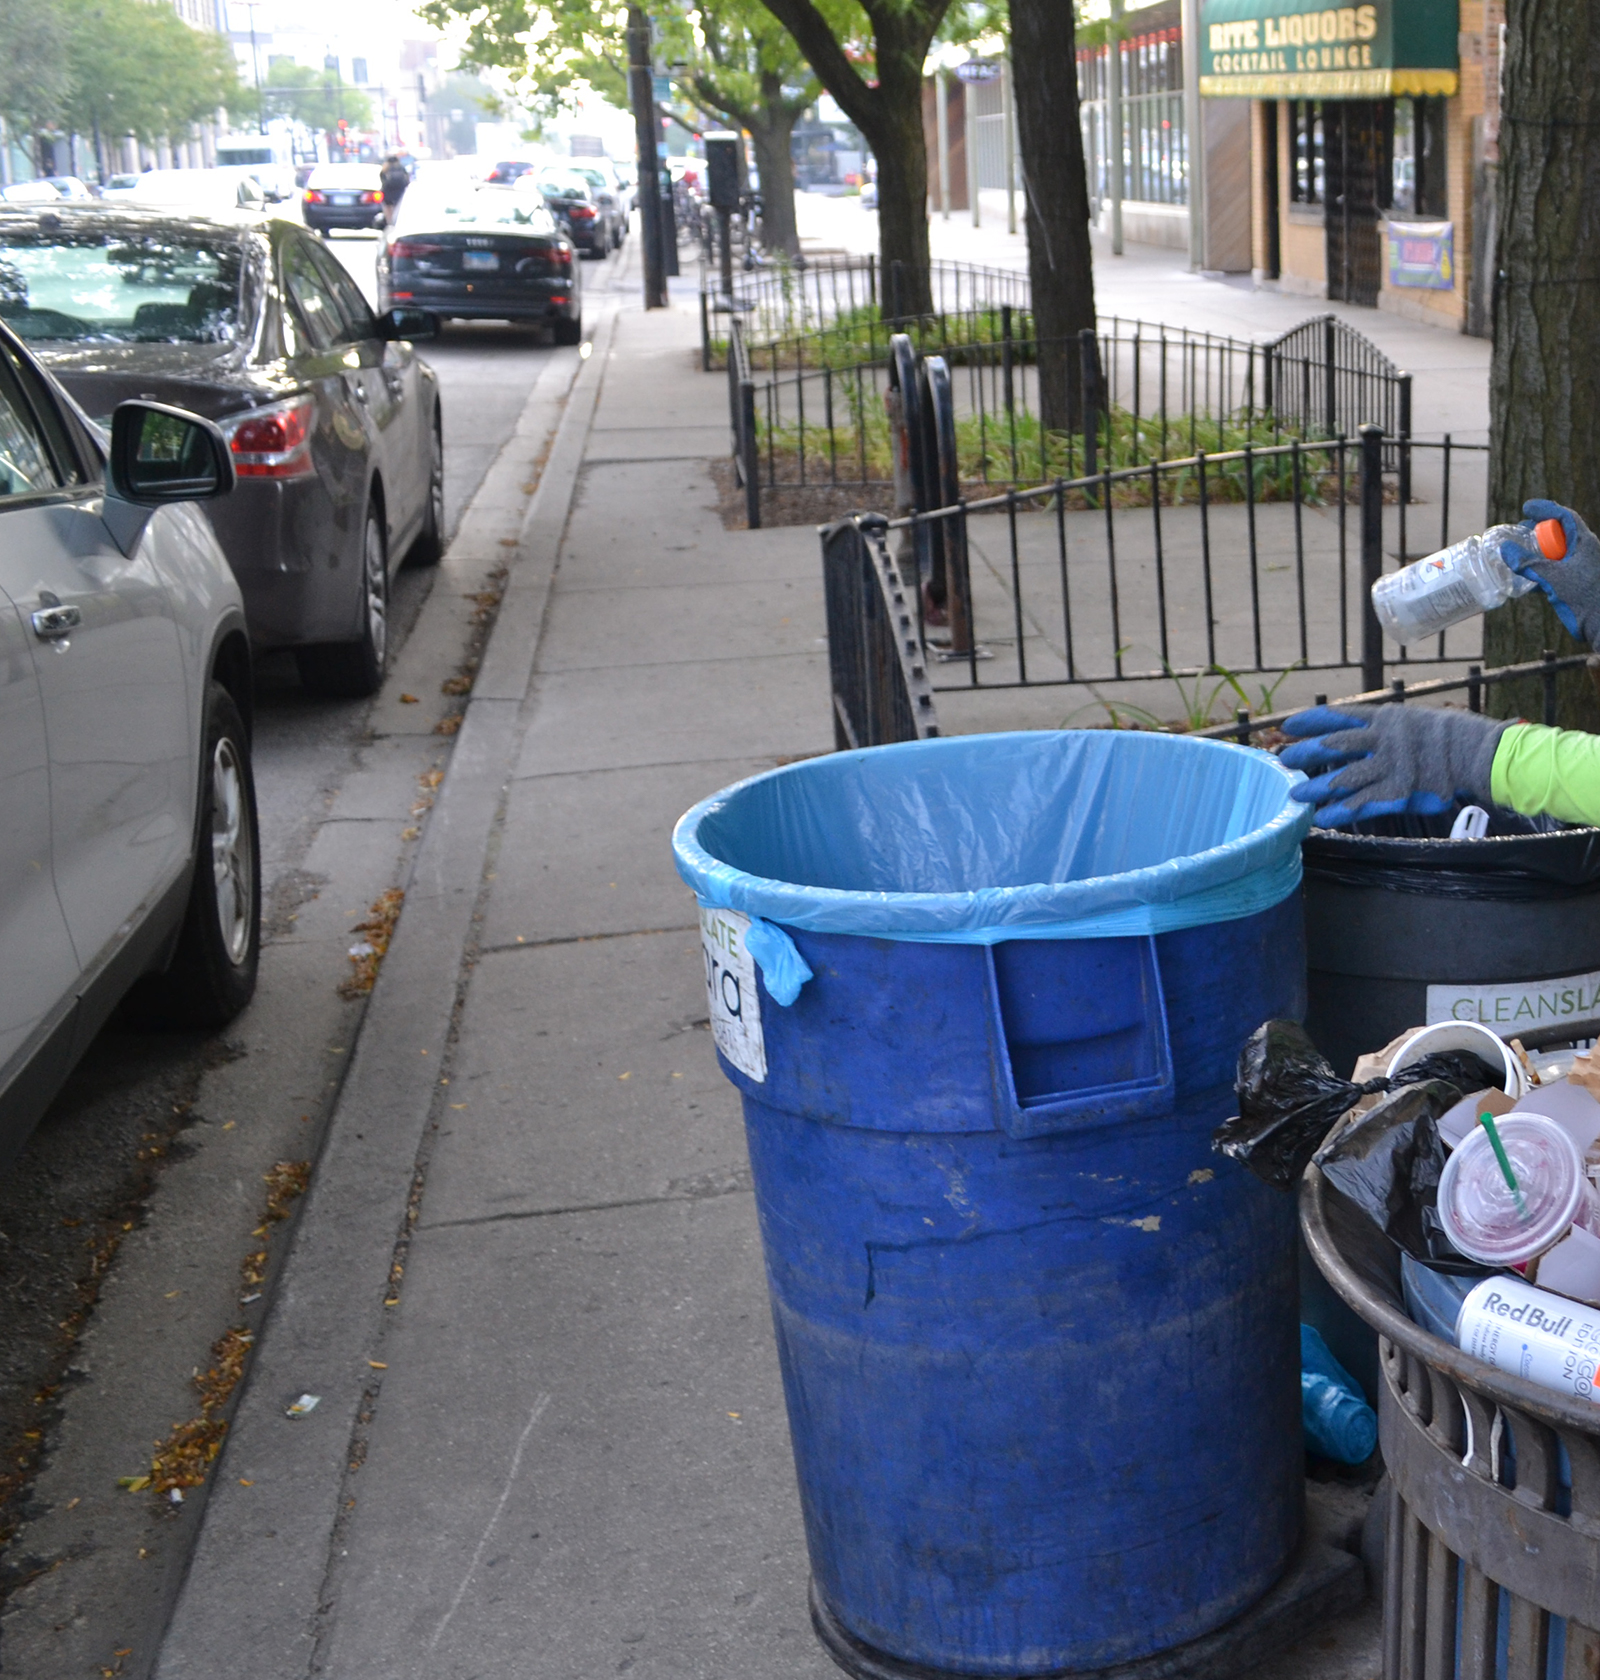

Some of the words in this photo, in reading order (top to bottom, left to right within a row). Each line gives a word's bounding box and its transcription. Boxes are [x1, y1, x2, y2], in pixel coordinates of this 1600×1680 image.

[1208, 20, 1259, 51] RITE
[1264, 4, 1378, 48] LIQUORS
[1212, 51, 1287, 74] COCKTAIL
[1296, 45, 1373, 70] LOUNGE
[1482, 1291, 1531, 1322] Red
[1525, 1307, 1573, 1338] Bull
